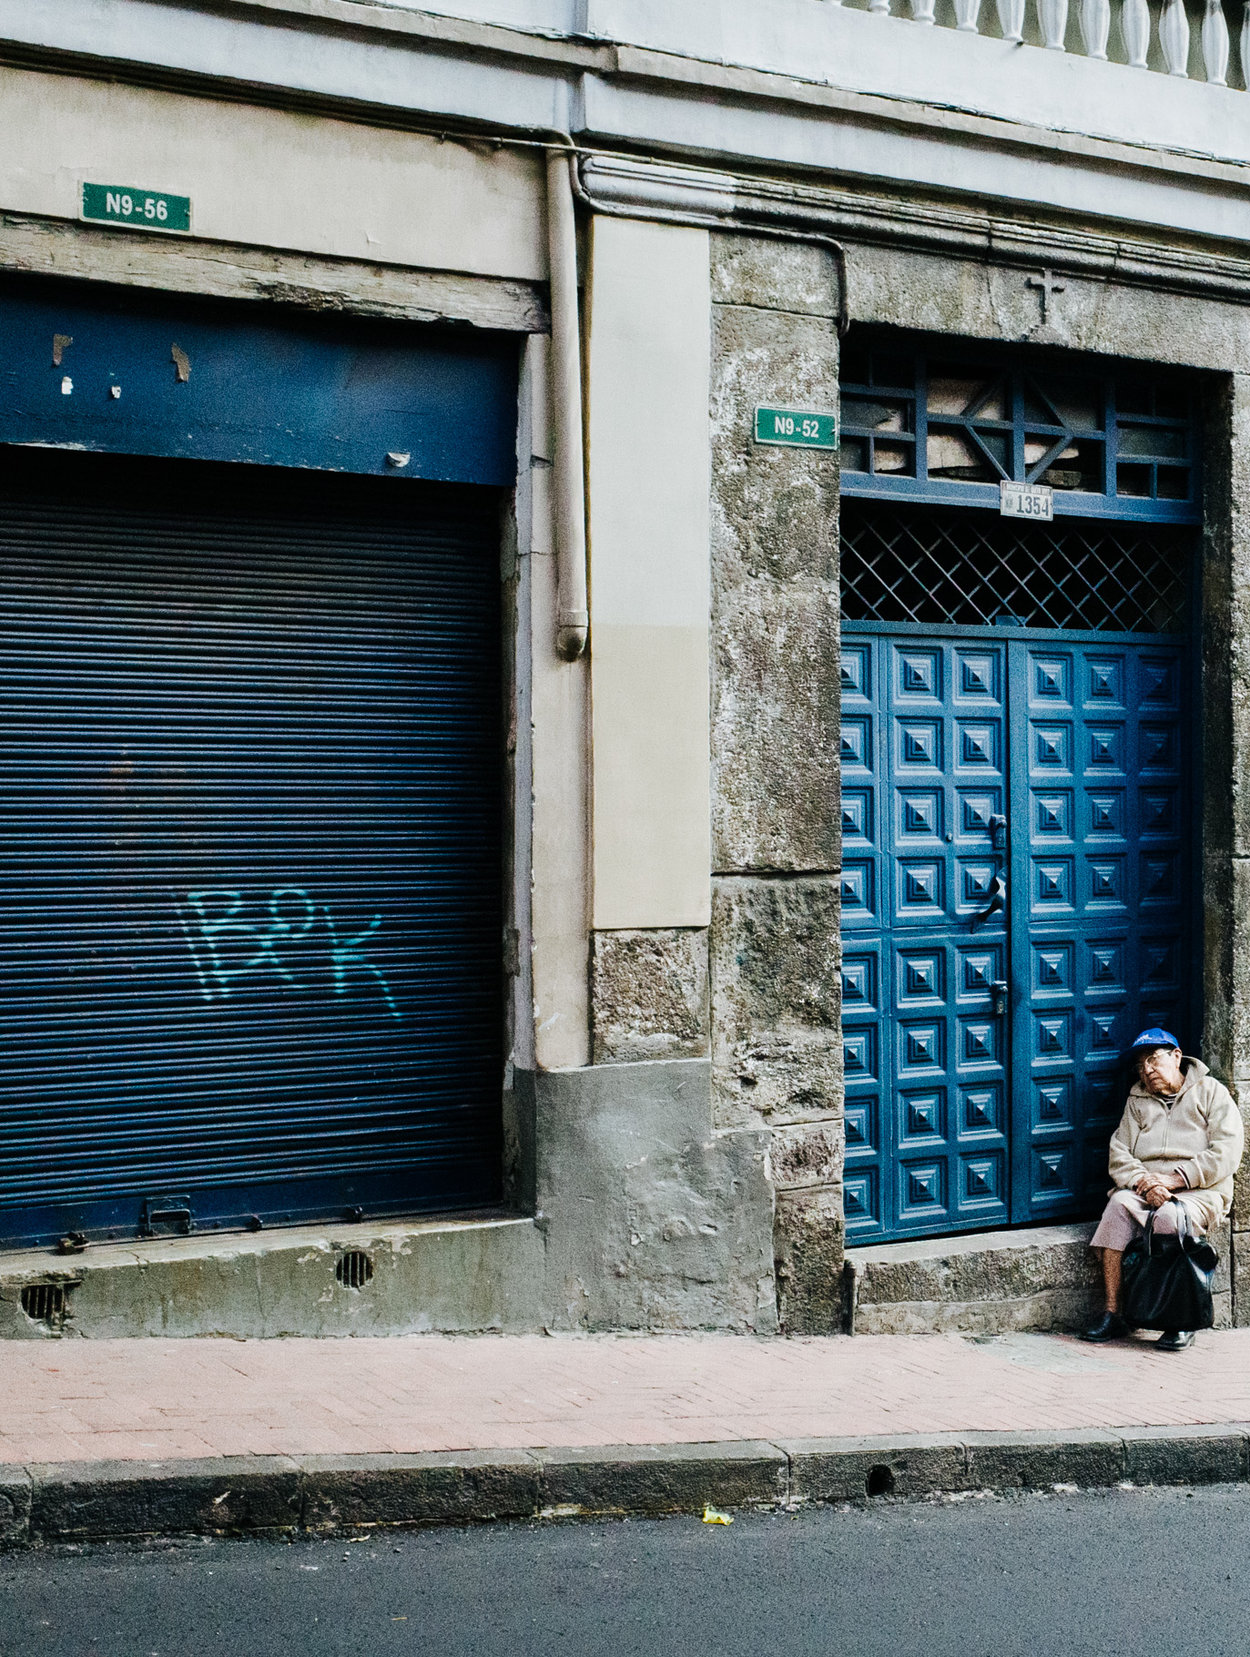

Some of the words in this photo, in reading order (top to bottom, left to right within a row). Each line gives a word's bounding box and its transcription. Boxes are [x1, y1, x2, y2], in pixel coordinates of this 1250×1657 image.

[106, 192, 168, 220] N9-56
[774, 416, 819, 438] N9-52
[1017, 494, 1049, 516] 1354
